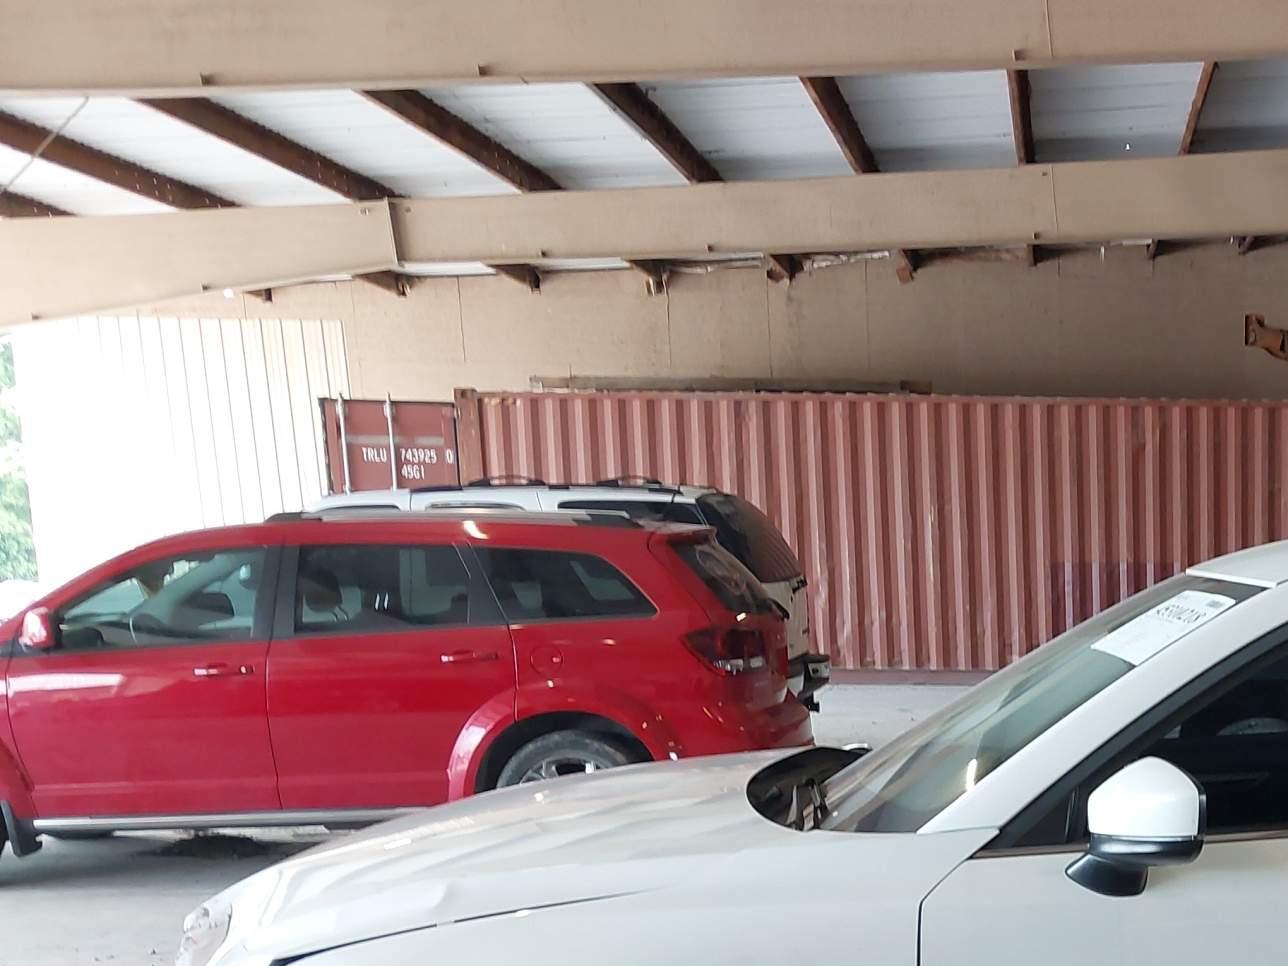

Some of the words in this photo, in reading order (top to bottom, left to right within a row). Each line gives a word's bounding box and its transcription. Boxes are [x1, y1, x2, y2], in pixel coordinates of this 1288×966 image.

[361, 447, 387, 463] TRLU
[400, 447, 438, 464] 743925
[445, 447, 454, 465] 0
[400, 463, 425, 480] 45G1
